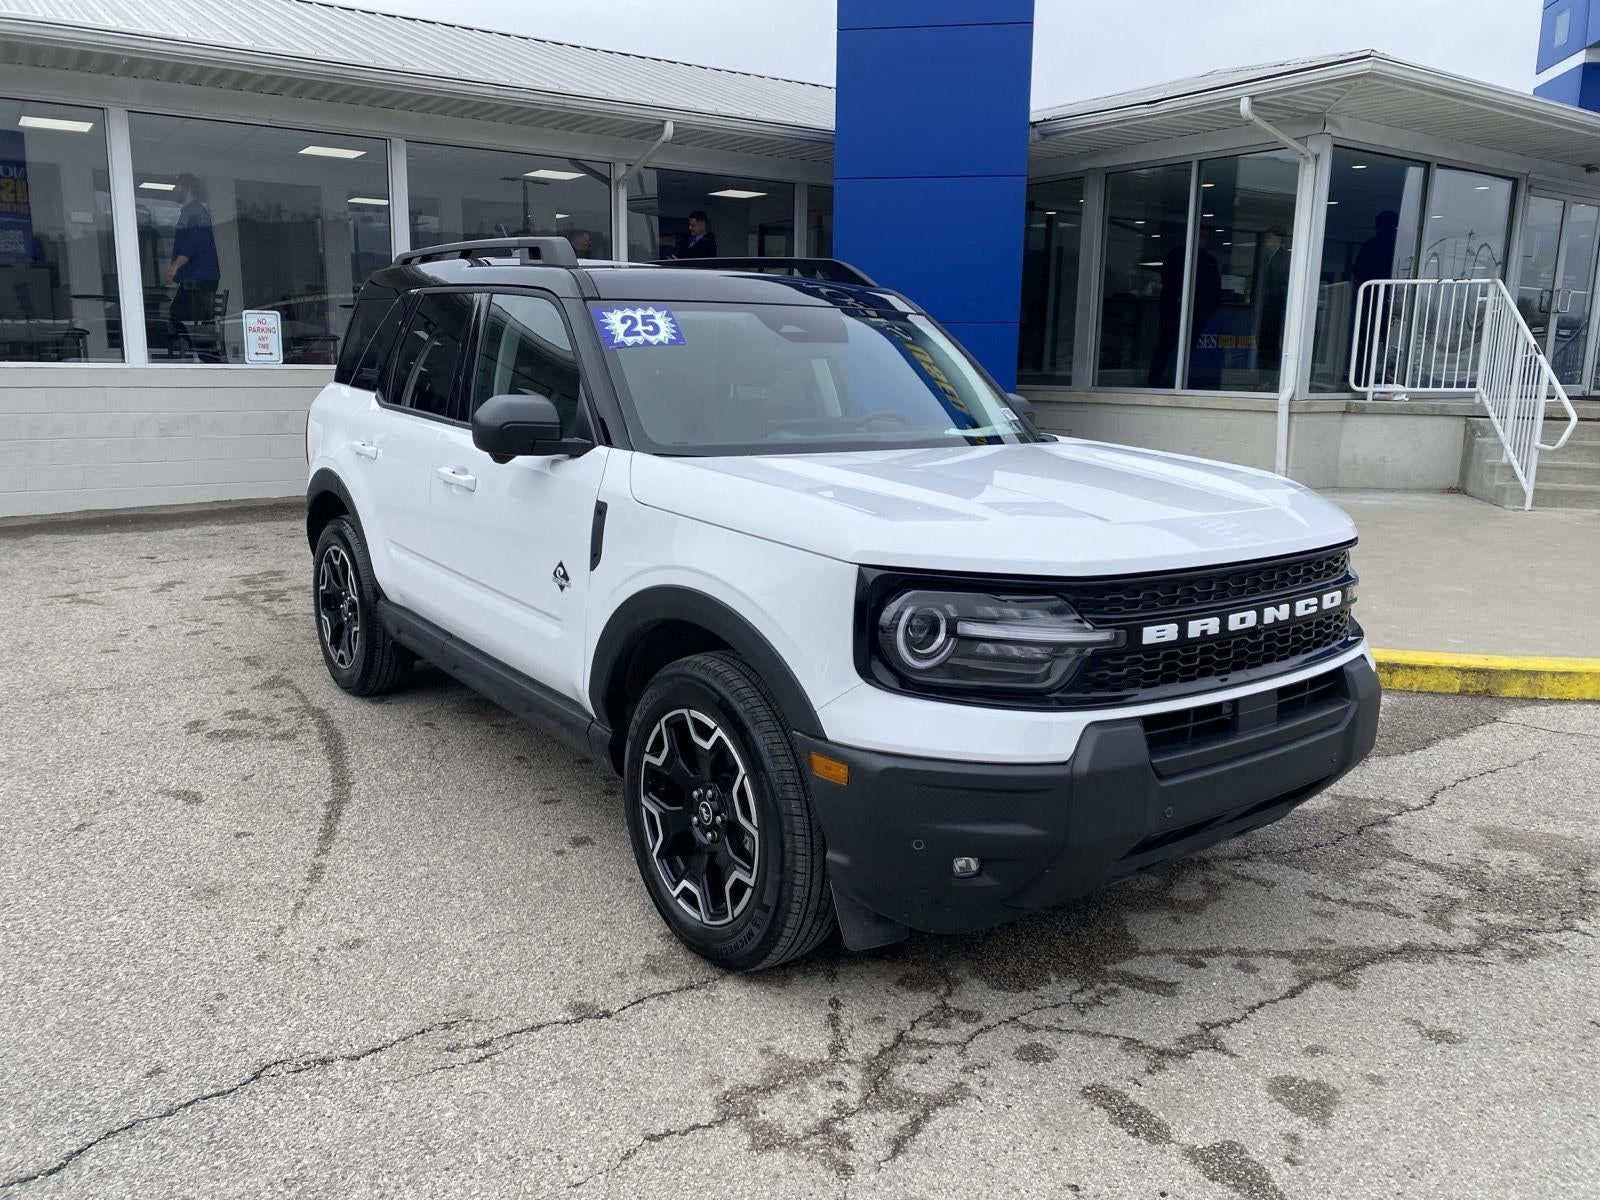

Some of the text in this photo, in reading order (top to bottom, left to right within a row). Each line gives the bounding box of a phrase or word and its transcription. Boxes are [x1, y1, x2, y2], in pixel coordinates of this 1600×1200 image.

[256, 317, 267, 326] NO
[619, 314, 661, 338] 25
[248, 326, 277, 335] PARKING
[1195, 334, 1218, 350] SES
[1142, 590, 1343, 645] BRONCO
